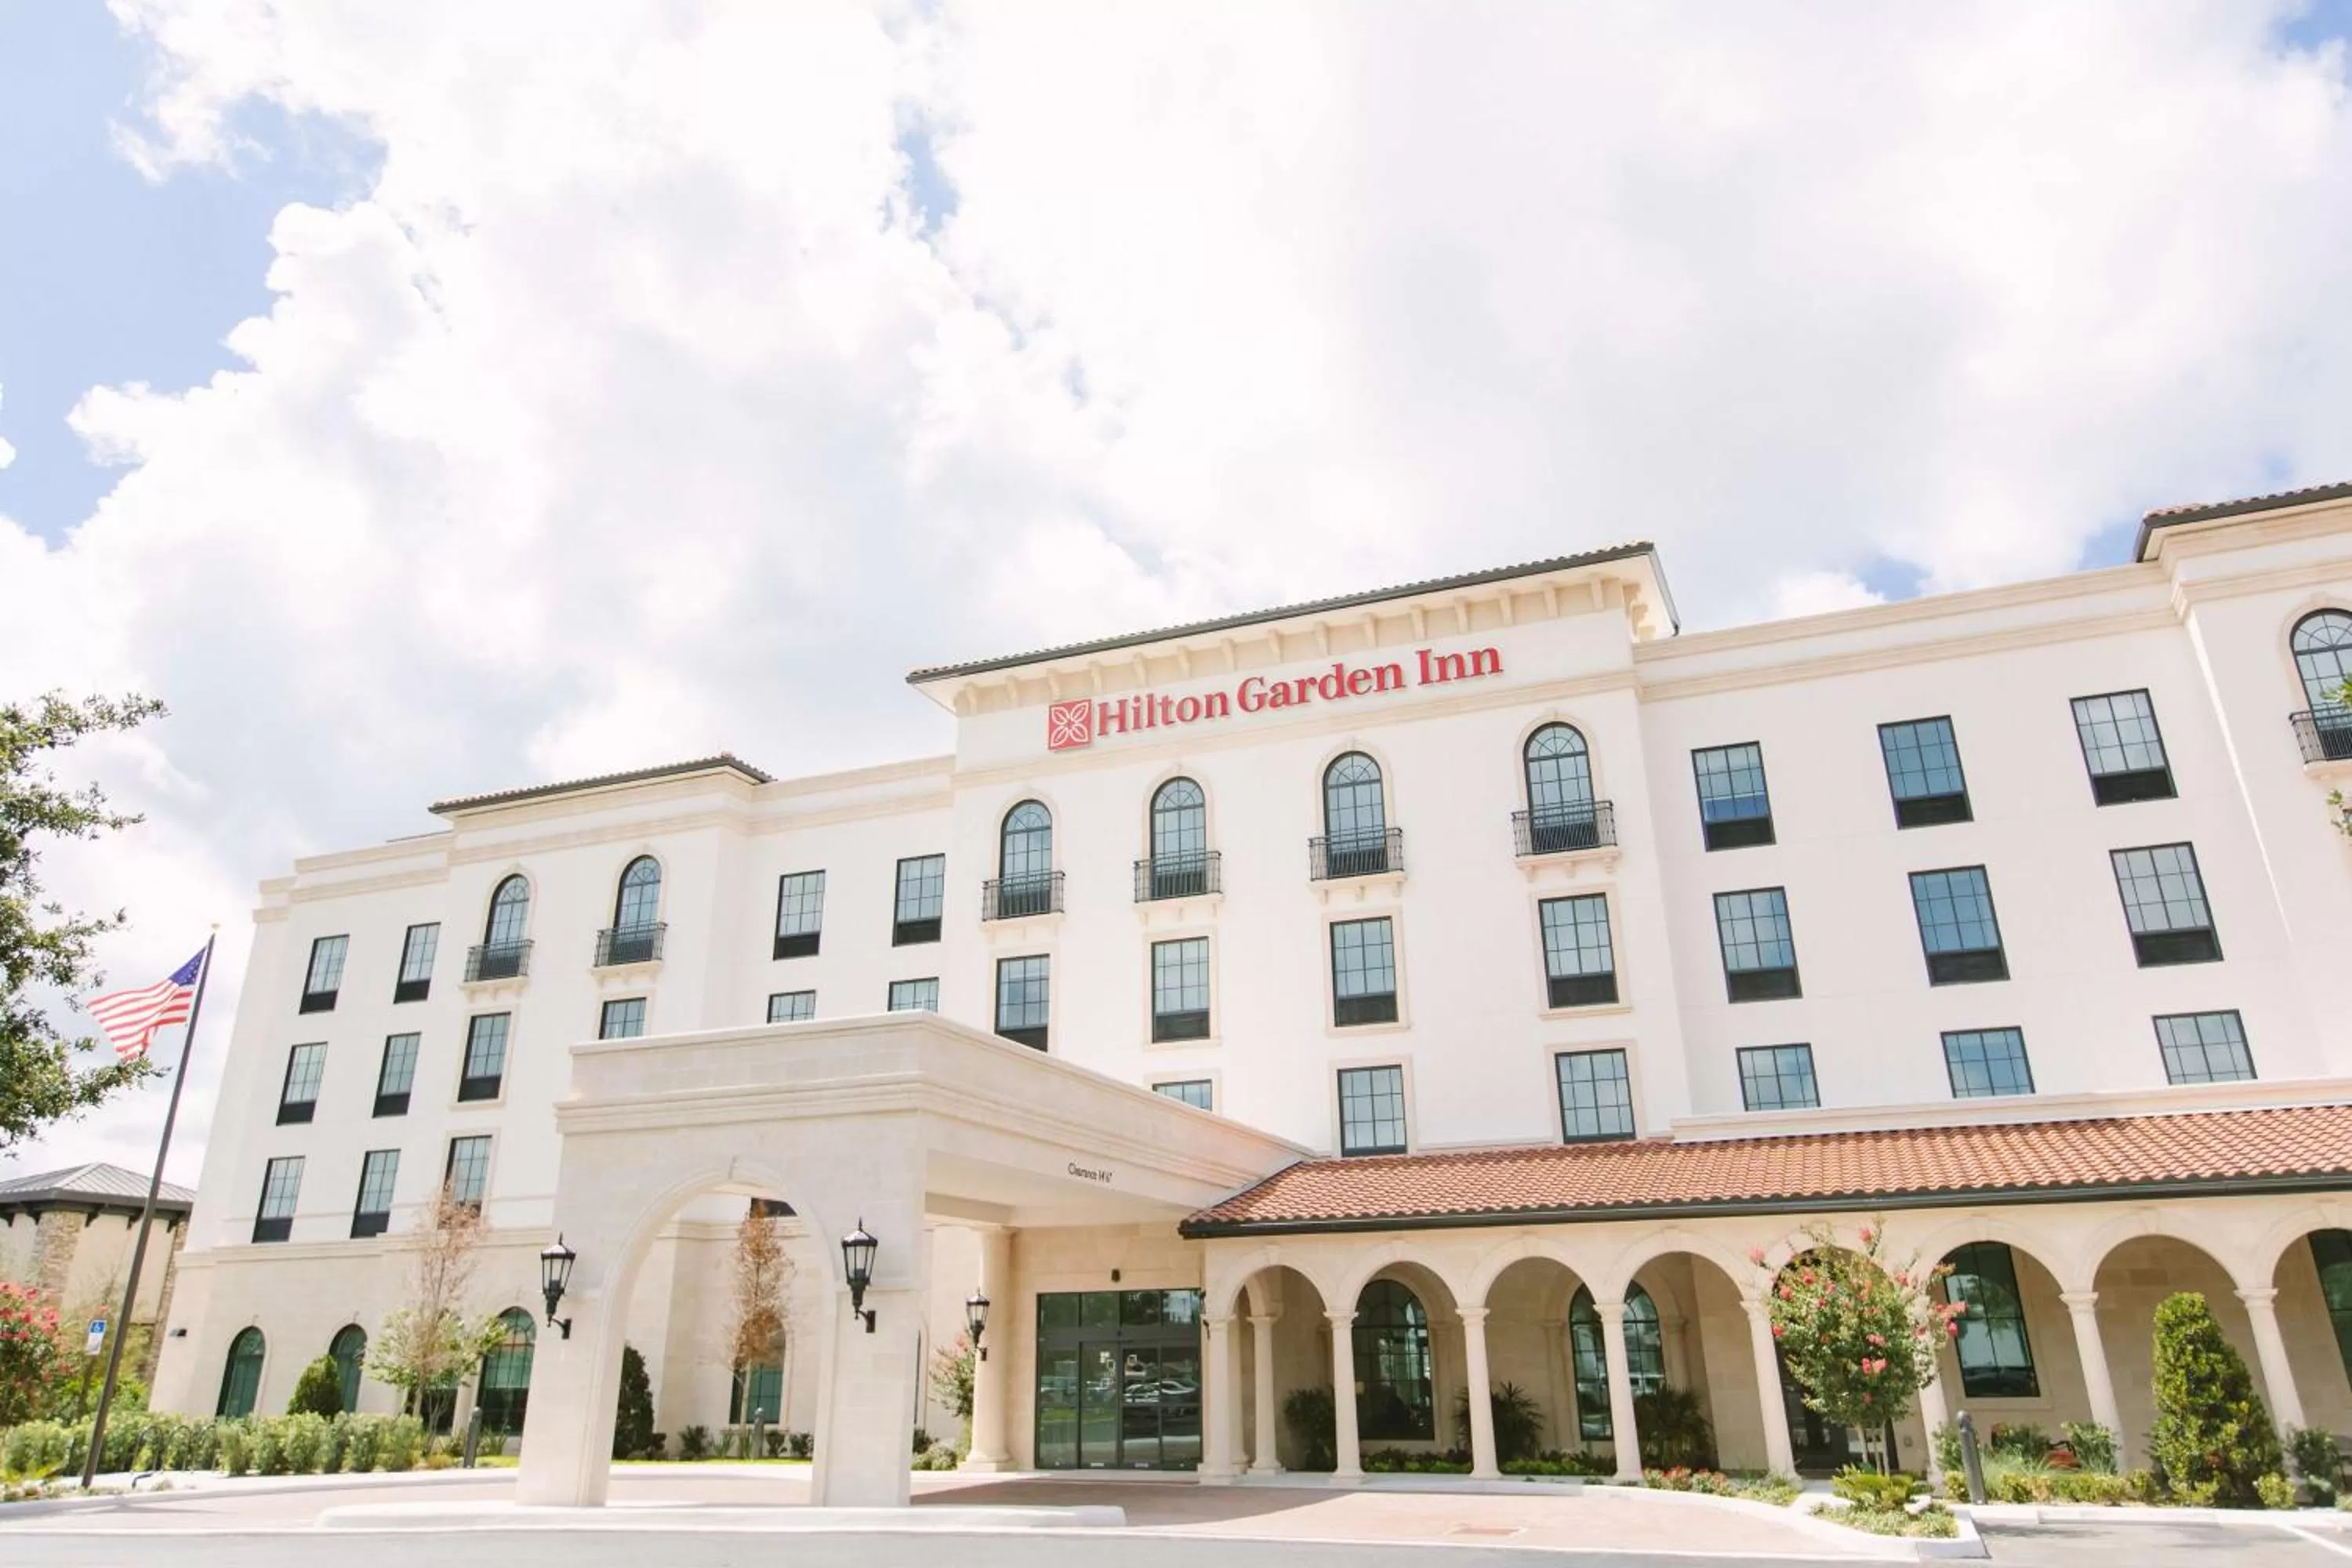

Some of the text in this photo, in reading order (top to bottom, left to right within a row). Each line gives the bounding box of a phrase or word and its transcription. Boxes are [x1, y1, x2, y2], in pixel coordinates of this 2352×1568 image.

[1096, 645, 1504, 737] Hilton Garden Inn
